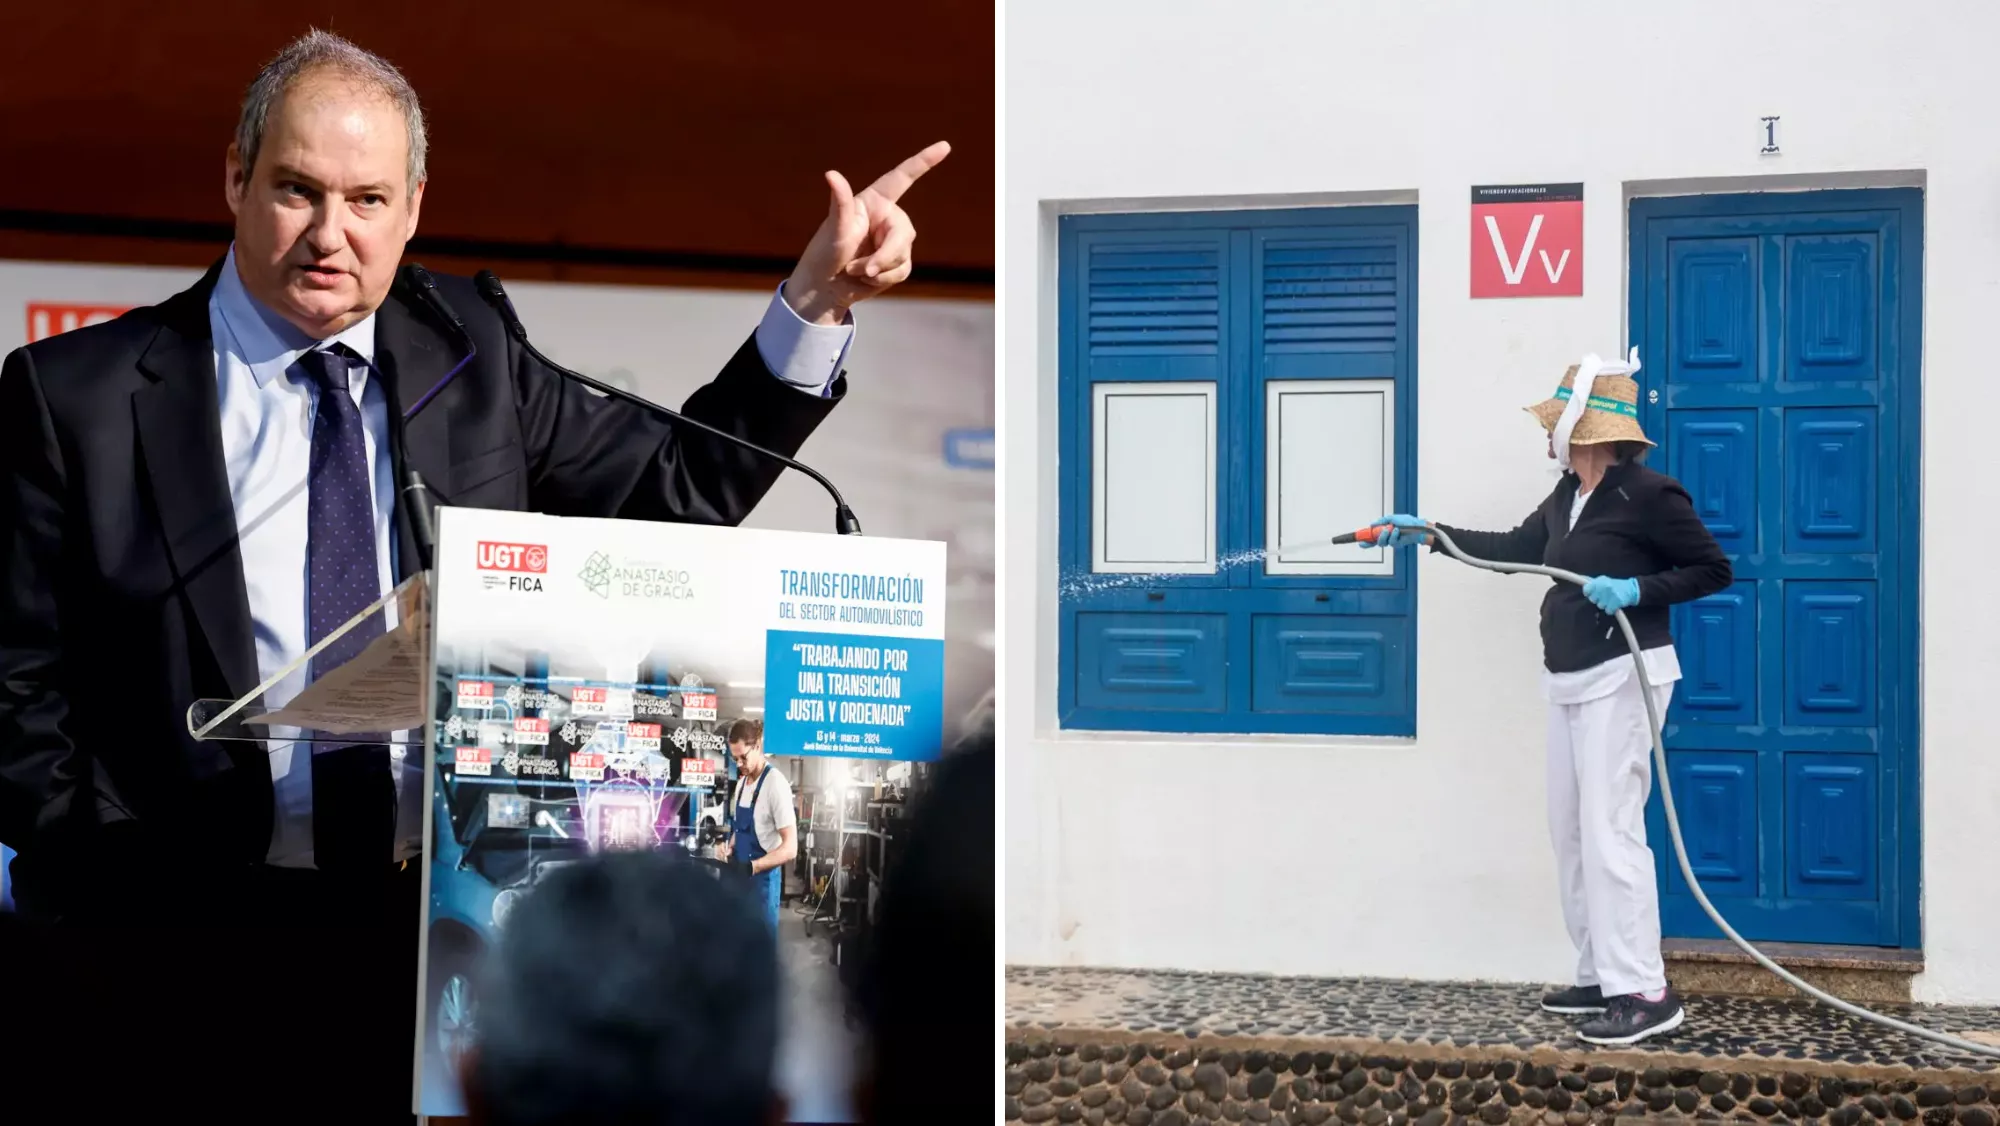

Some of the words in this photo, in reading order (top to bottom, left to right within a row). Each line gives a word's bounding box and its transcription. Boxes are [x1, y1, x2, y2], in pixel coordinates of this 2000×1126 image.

[1765, 121, 1775, 146] 1
[1480, 188, 1507, 196] VIVIENDAS
[1508, 187, 1547, 195] VACACIONALES
[478, 543, 525, 568] UGT
[612, 568, 690, 585] ANASTASIO
[509, 576, 544, 592] FICA
[622, 582, 640, 597] DE
[643, 583, 695, 599] GRACIA
[780, 569, 924, 604] TRANSFORMACIÓN
[779, 602, 796, 619] DEL
[800, 603, 836, 621] SECTOR
[839, 606, 924, 627] AUTOMOVILÍSTICO
[883, 649, 909, 672] POR
[458, 682, 481, 696] UGT
[798, 671, 824, 694] UNA
[827, 672, 901, 699] TRANSICIÓN
[572, 689, 595, 701] UGT
[684, 695, 706, 708] UGT
[587, 705, 604, 713] FICA
[633, 698, 671, 707] ANASTASIO
[637, 706, 647, 714] DE
[647, 706, 674, 716] GRACIA
[698, 710, 714, 718] FICA
[786, 698, 825, 722] JUSTA
[828, 700, 838, 723] Y
[515, 720, 538, 732] UGT
[628, 724, 650, 737] UGT
[529, 734, 546, 742] FICA
[642, 739, 658, 747] FICA
[688, 734, 725, 743] ANASTASIO
[816, 730, 824, 742] 13
[824, 733, 829, 743] y
[829, 731, 837, 742] 14
[840, 733, 860, 744] marzo
[864, 733, 880, 744] 2024
[692, 741, 702, 749] DE
[702, 742, 727, 751] GRACIA
[456, 748, 479, 761] UGT
[570, 754, 593, 767] UGT
[682, 760, 704, 772] UGT
[585, 769, 601, 778] FICA
[696, 776, 713, 784] FICA
